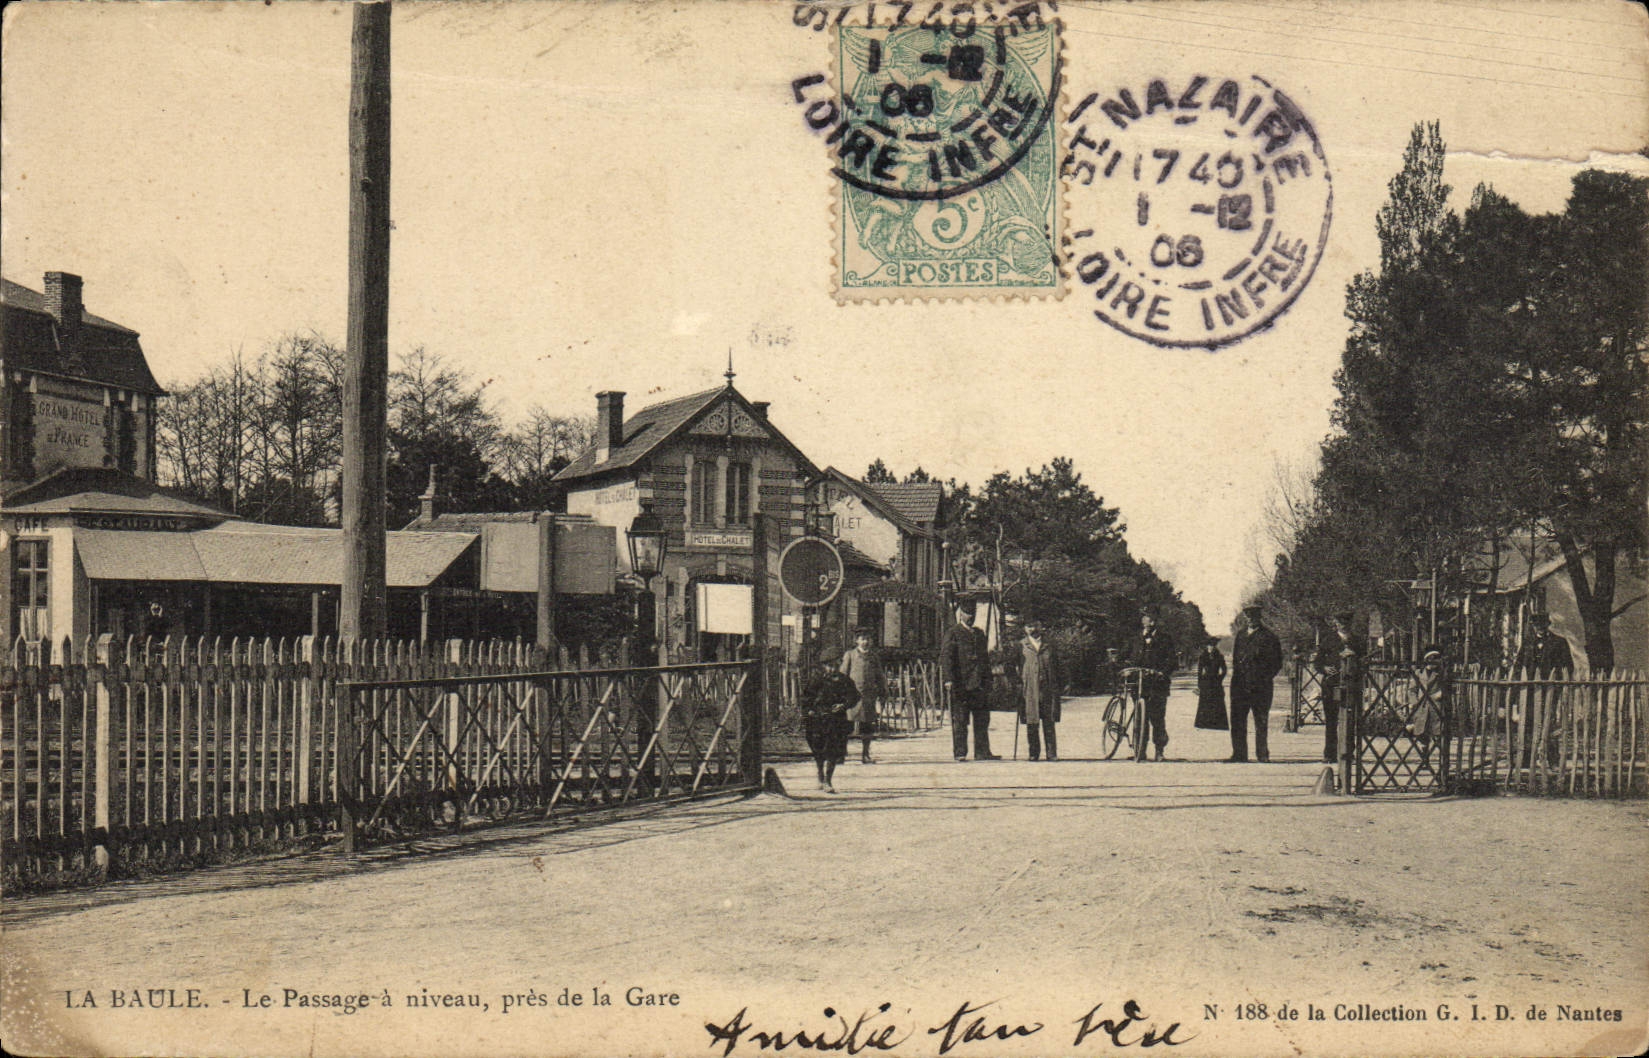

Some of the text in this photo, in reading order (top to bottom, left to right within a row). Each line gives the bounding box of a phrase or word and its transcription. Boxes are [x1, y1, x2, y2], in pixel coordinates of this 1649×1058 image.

[791, 73, 901, 181] LOIRE
[1100, 75, 1314, 186] NAZAIRE
[902, 261, 995, 284] POSTES
[39, 401, 69, 419] GRAND
[55, 427, 90, 449] FRANCE
[722, 535, 751, 545] CHALET
